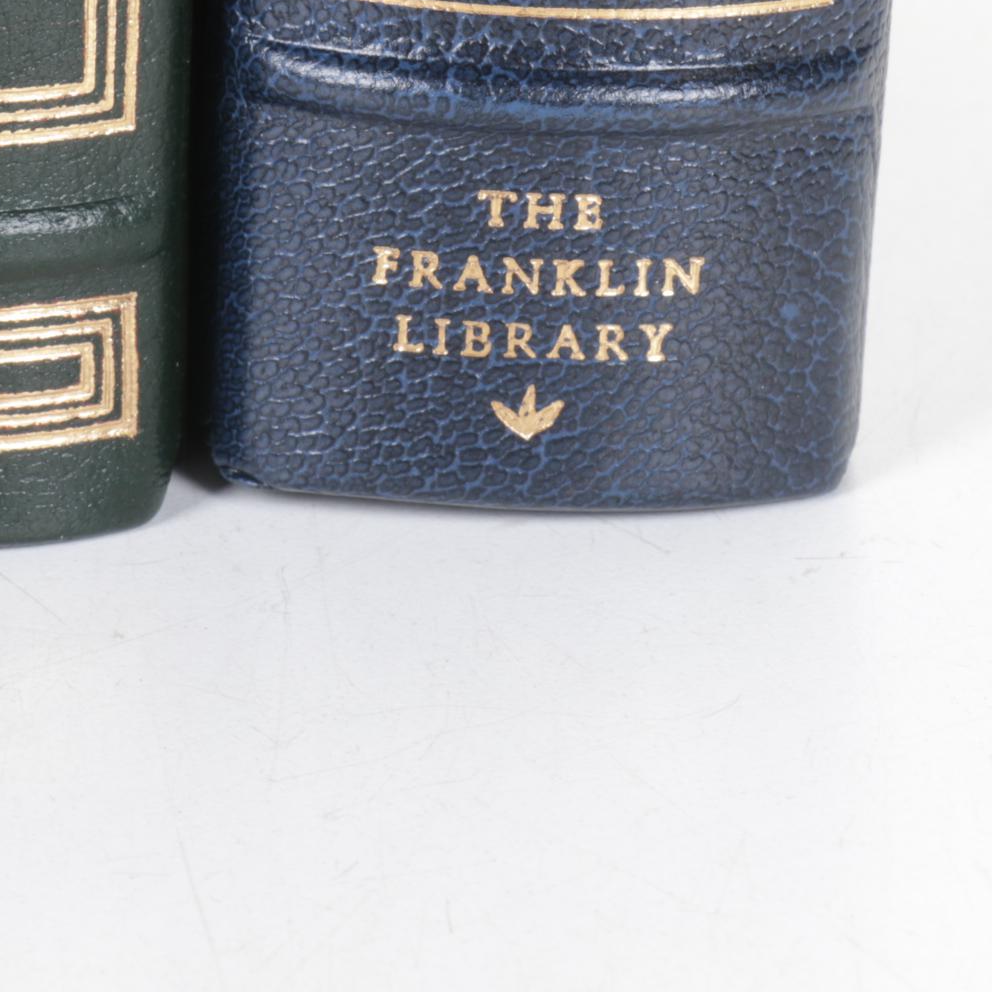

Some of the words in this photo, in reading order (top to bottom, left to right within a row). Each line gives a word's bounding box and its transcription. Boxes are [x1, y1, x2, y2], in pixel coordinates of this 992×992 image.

[478, 190, 603, 230] THE
[372, 245, 705, 296] FRANKLIN
[392, 315, 673, 362] LIBRARY
